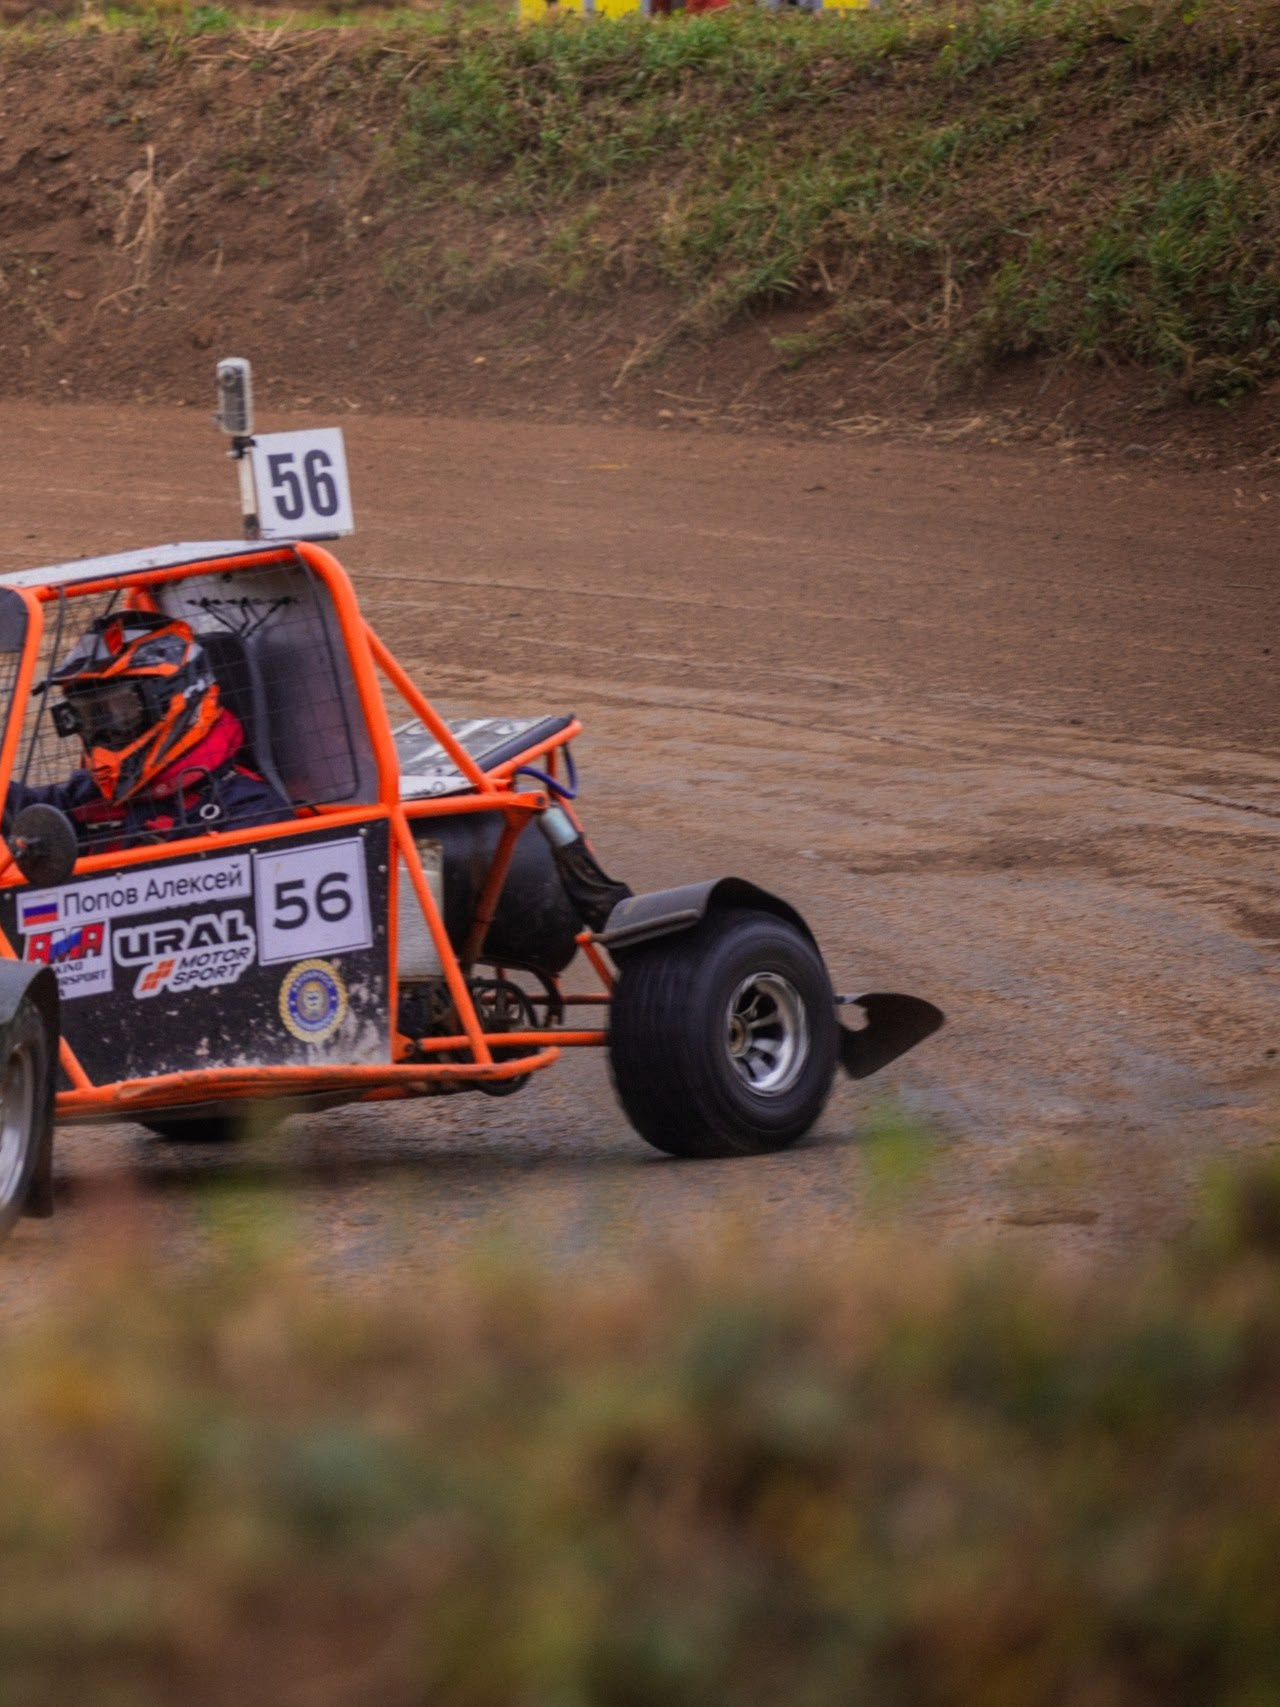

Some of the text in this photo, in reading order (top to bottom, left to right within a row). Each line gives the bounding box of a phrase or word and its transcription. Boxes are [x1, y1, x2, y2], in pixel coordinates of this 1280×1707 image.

[267, 449, 339, 520] 56
[64, 863, 243, 917] Попов Алексей
[272, 871, 352, 931] 56
[119, 917, 250, 960] URAL
[178, 946, 251, 971] MOTOR
[172, 962, 241, 986] SPORT
